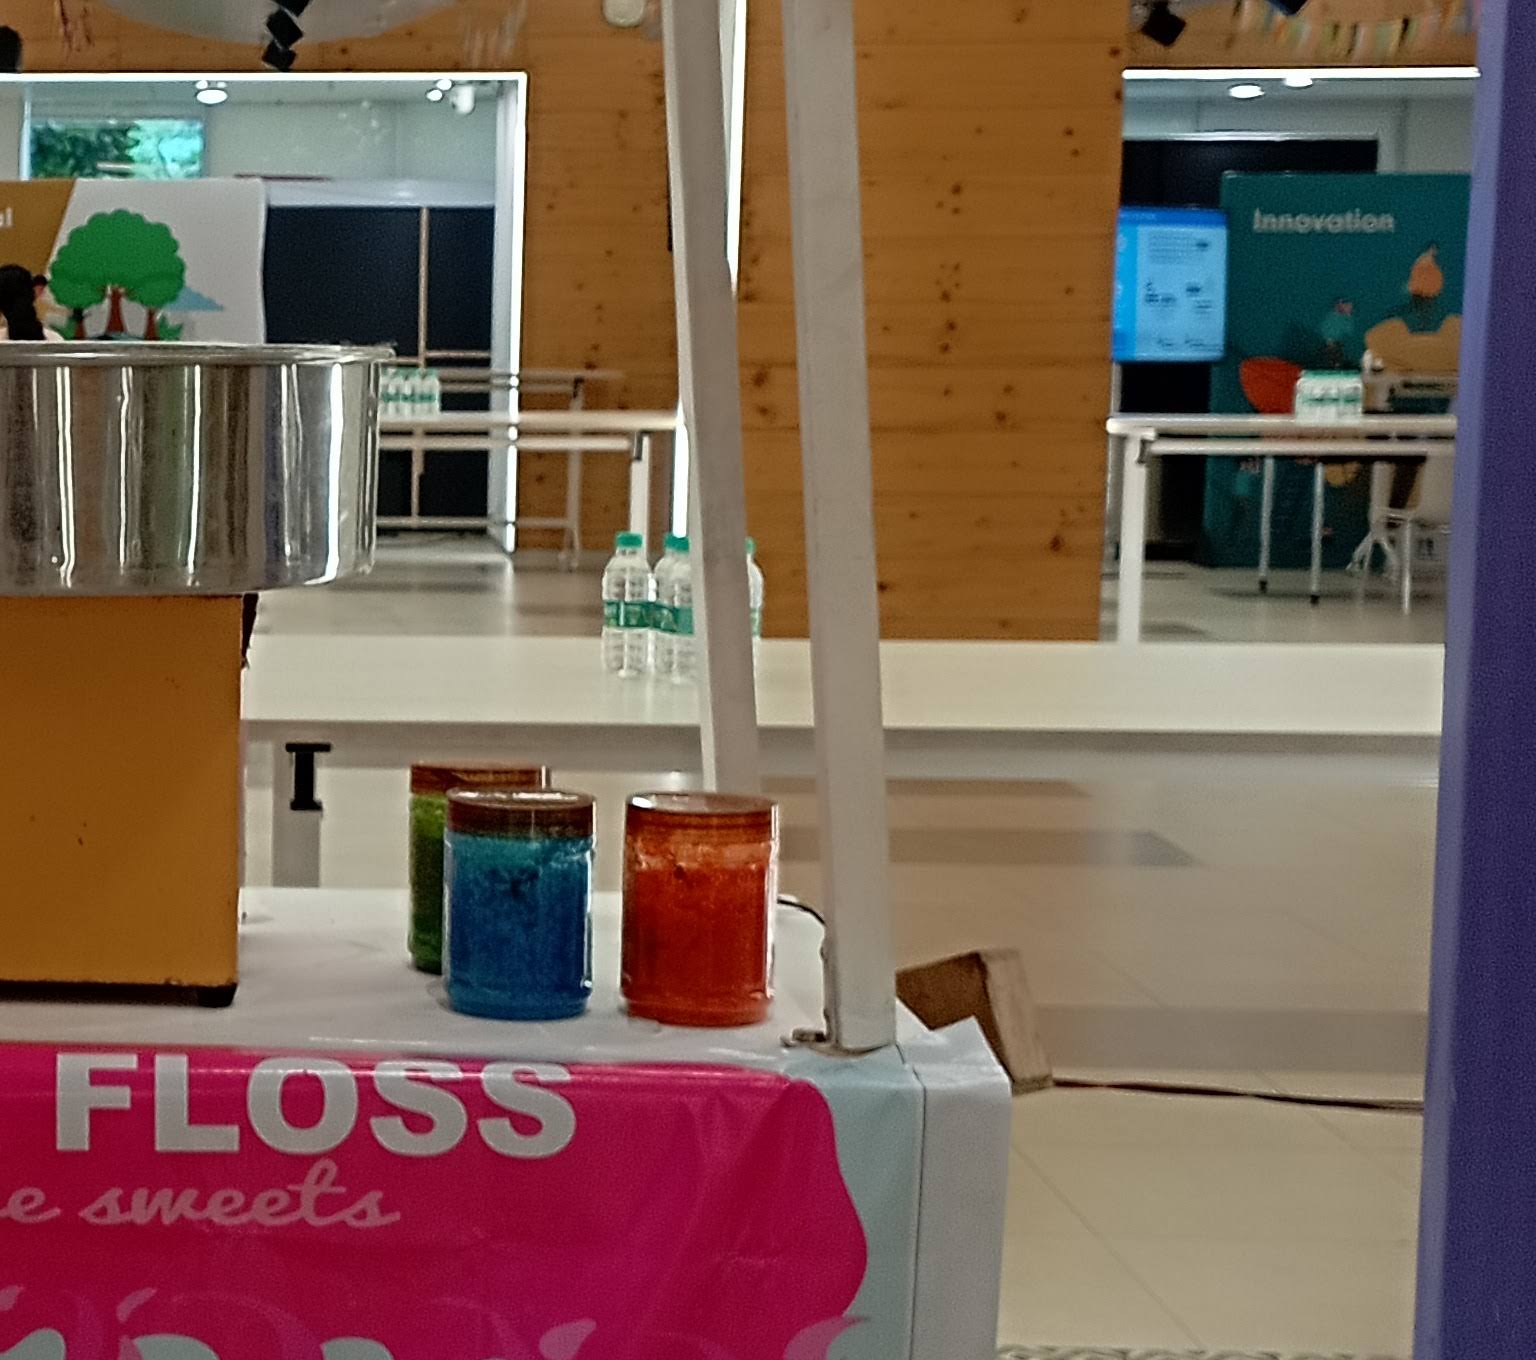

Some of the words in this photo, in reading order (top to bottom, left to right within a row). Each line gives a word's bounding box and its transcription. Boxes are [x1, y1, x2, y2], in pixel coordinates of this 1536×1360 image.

[1253, 208, 1394, 233] Innovation
[54, 1051, 578, 1158] FLOSS
[78, 1157, 402, 1230] sweets
